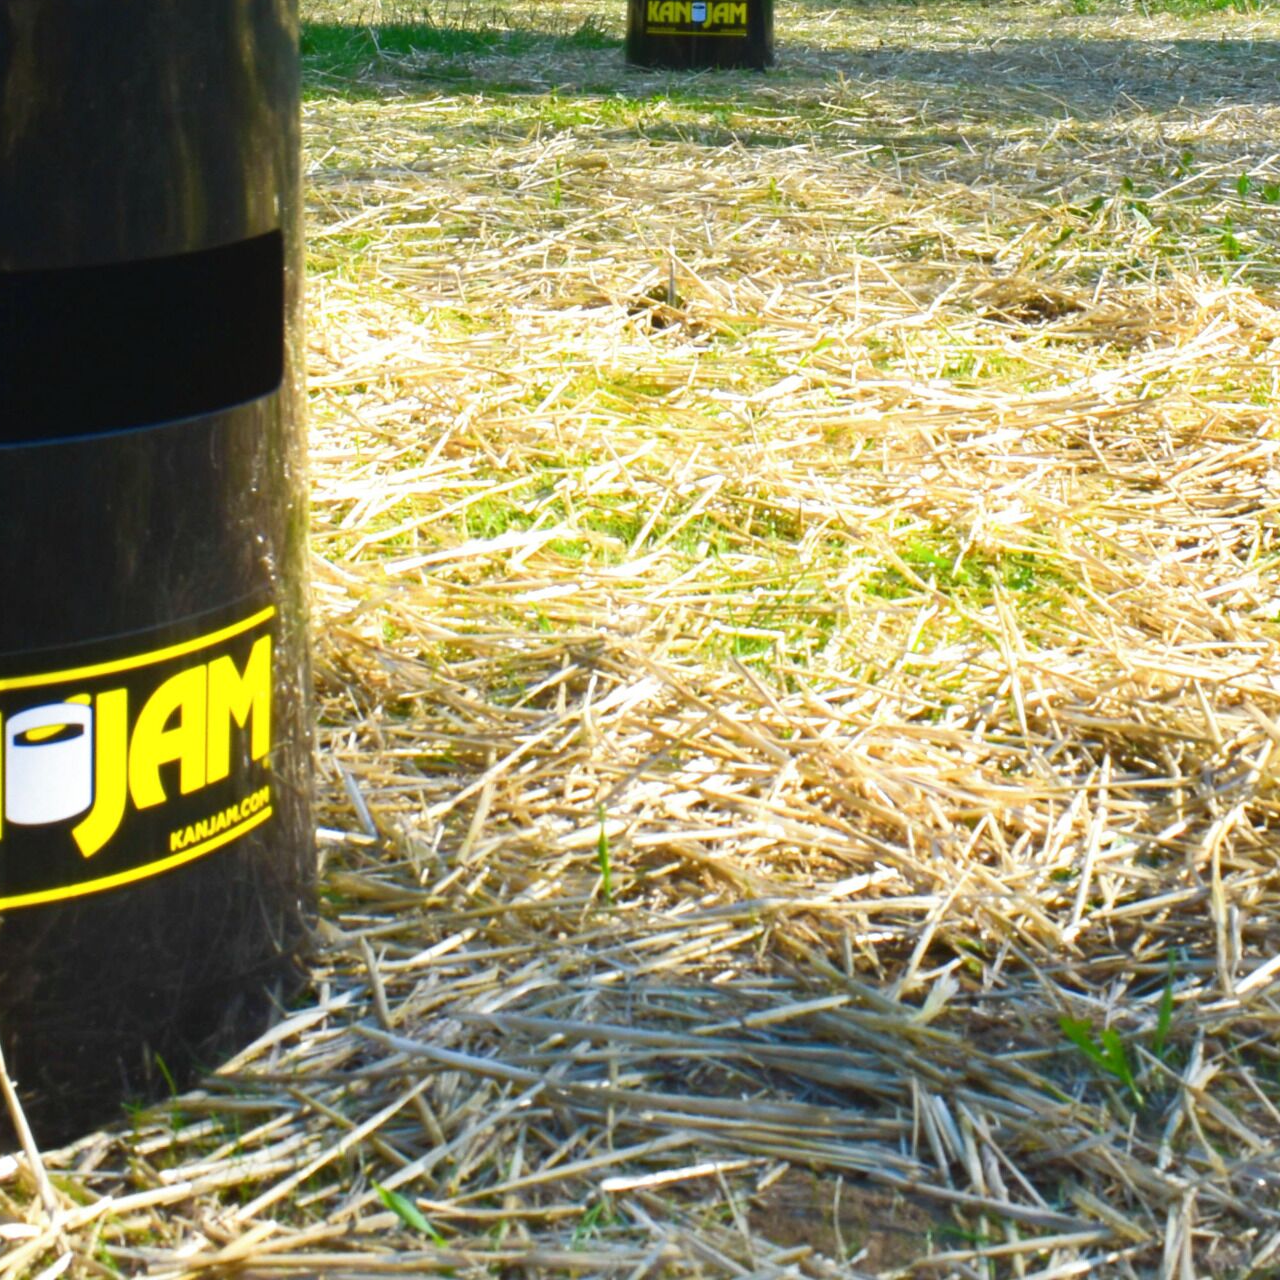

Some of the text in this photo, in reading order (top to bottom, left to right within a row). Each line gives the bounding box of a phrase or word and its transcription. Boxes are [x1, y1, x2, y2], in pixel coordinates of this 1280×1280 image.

[648, 0, 747, 28] KAN JAM
[72, 634, 270, 858] JAM
[169, 784, 270, 853] KANJAM.COM
